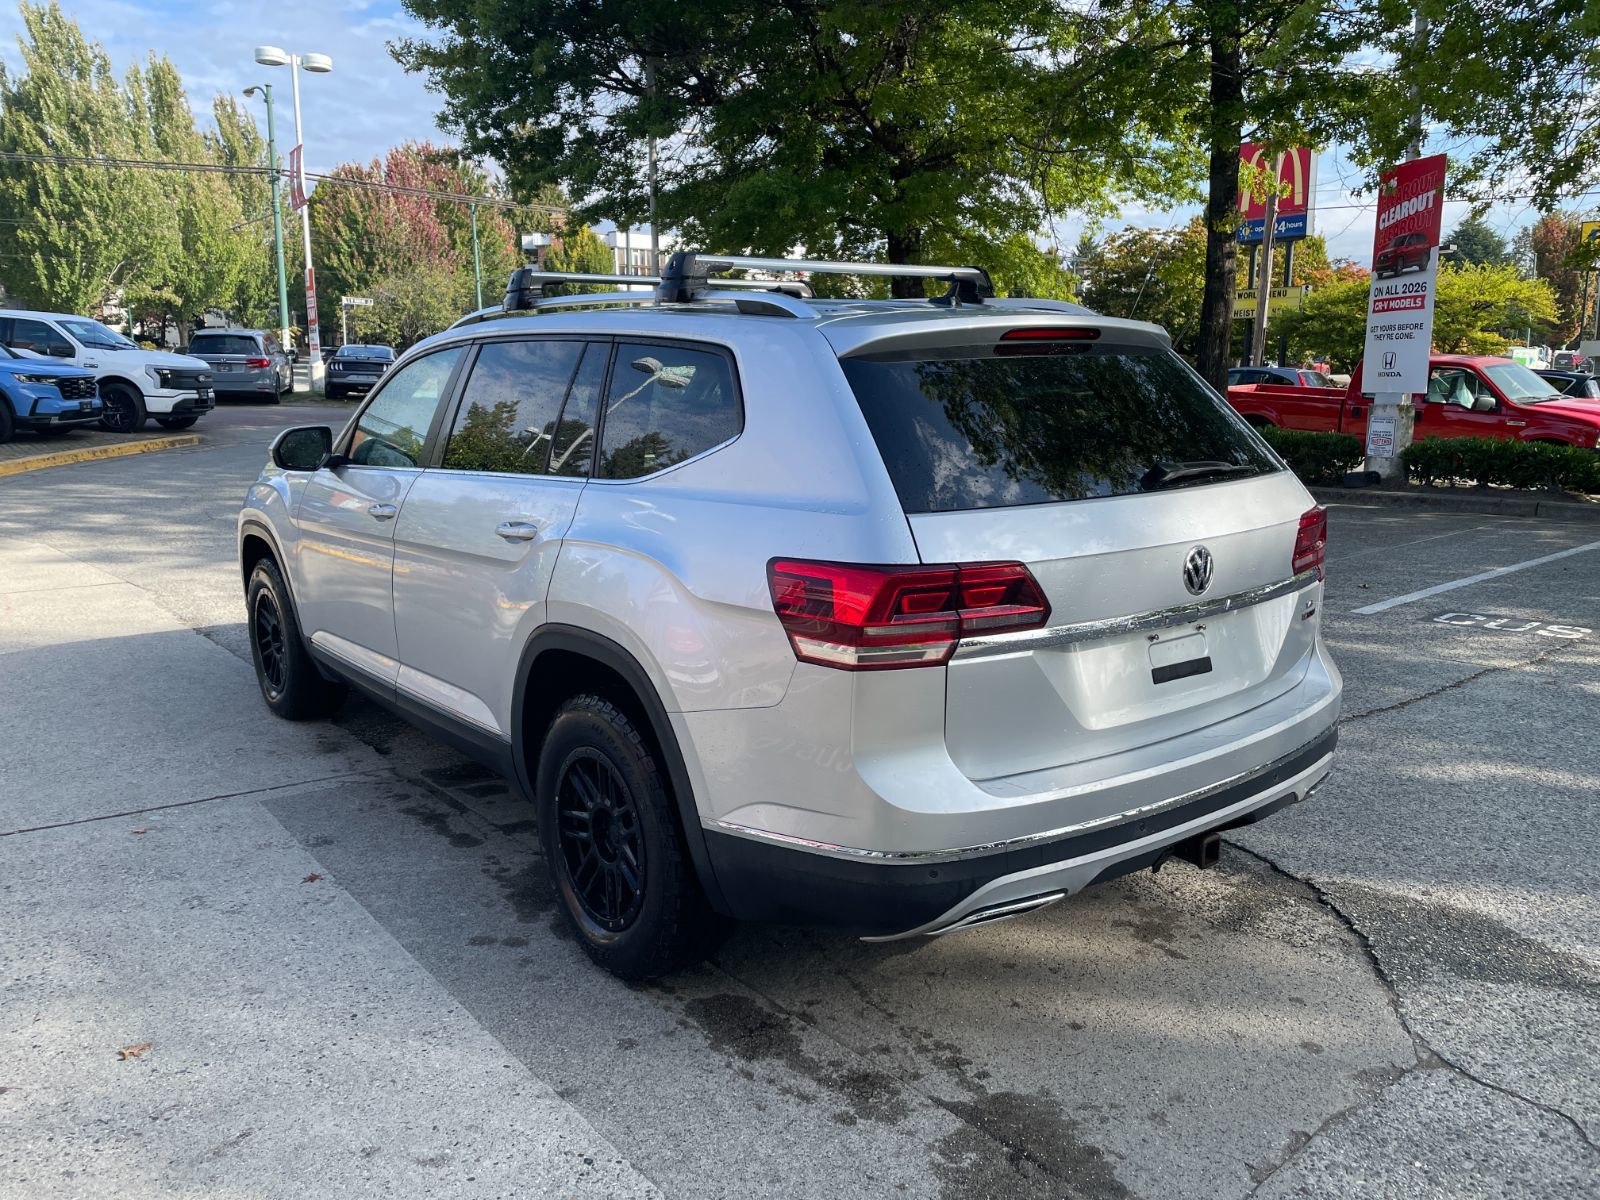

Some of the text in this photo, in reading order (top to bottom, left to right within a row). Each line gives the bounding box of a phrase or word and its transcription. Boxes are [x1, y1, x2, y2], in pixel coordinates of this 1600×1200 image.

[1379, 190, 1436, 230] CLEAROUT
[1287, 221, 1303, 229] hours
[1238, 291, 1257, 300] WORL
[1374, 282, 1427, 298] ON ALL 2026
[1374, 298, 1422, 311] CR-V MODELS
[1380, 324, 1397, 332] YOURS
[1397, 322, 1424, 331] BEFORE
[1433, 612, 1593, 639] CUS
